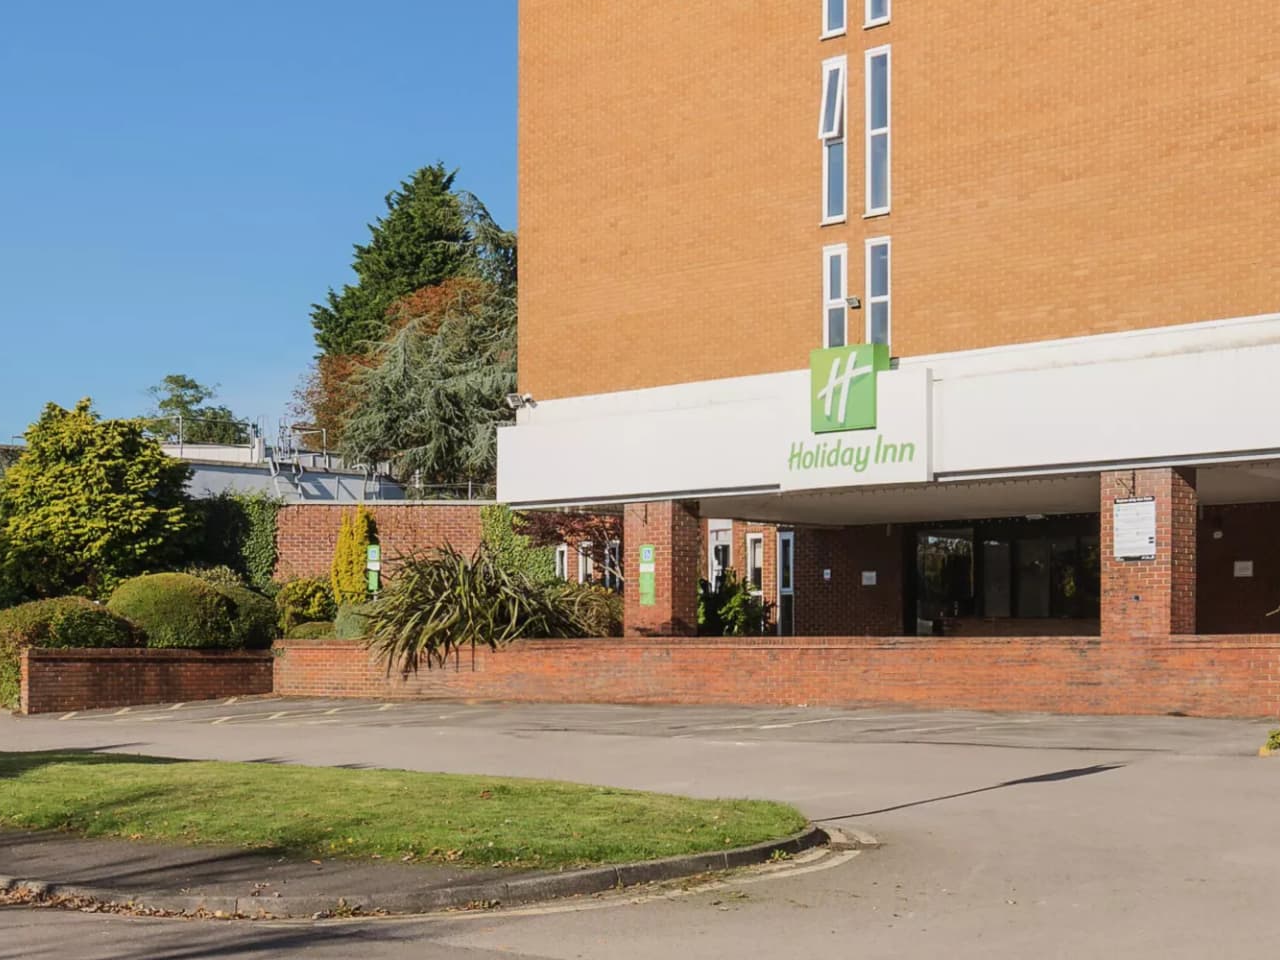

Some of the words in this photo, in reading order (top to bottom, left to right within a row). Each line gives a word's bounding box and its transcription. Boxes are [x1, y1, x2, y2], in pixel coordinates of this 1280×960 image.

[817, 351, 873, 424] H
[788, 439, 871, 473] Holiday
[874, 434, 916, 465] Inn
